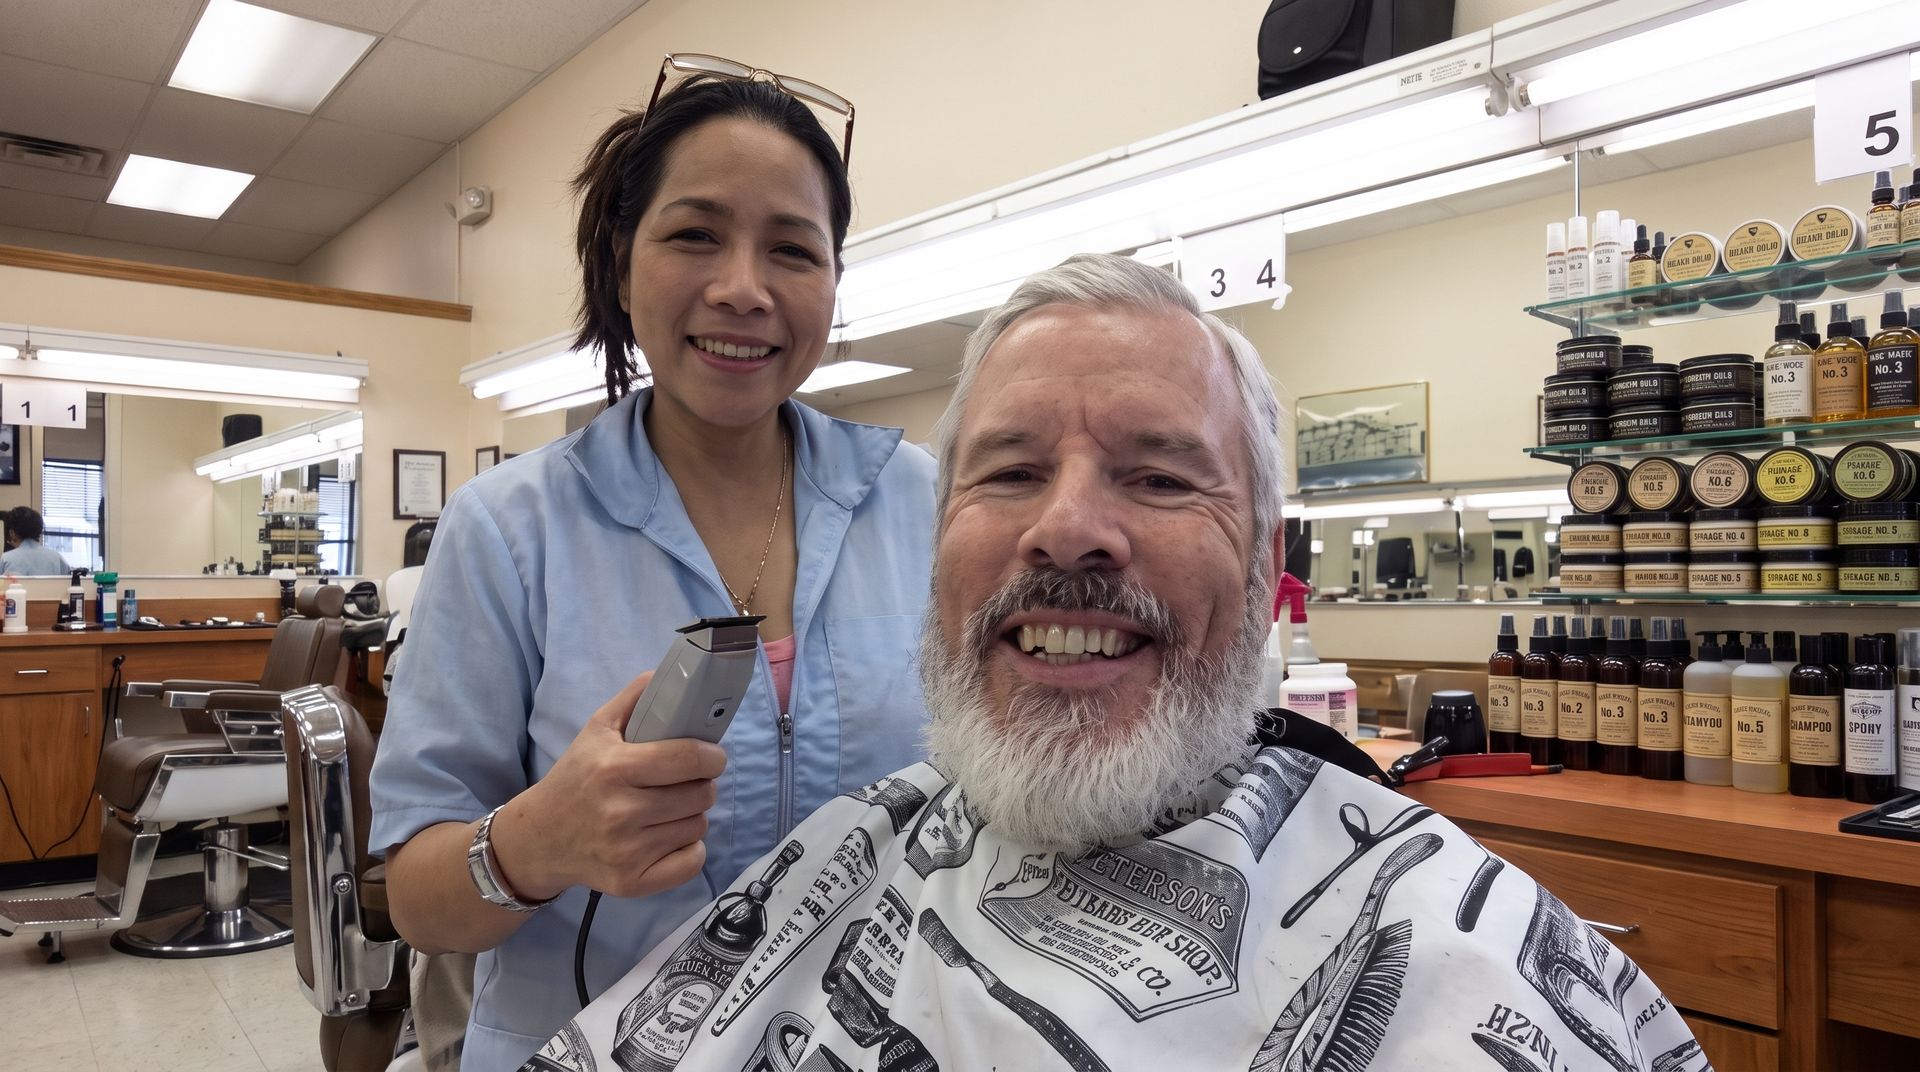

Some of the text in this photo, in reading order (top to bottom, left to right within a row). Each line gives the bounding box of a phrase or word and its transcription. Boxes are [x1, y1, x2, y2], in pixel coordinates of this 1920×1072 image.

[1864, 110, 1900, 156] 5
[1210, 259, 1276, 297] 3 4
[21, 401, 77, 422] 1 1
